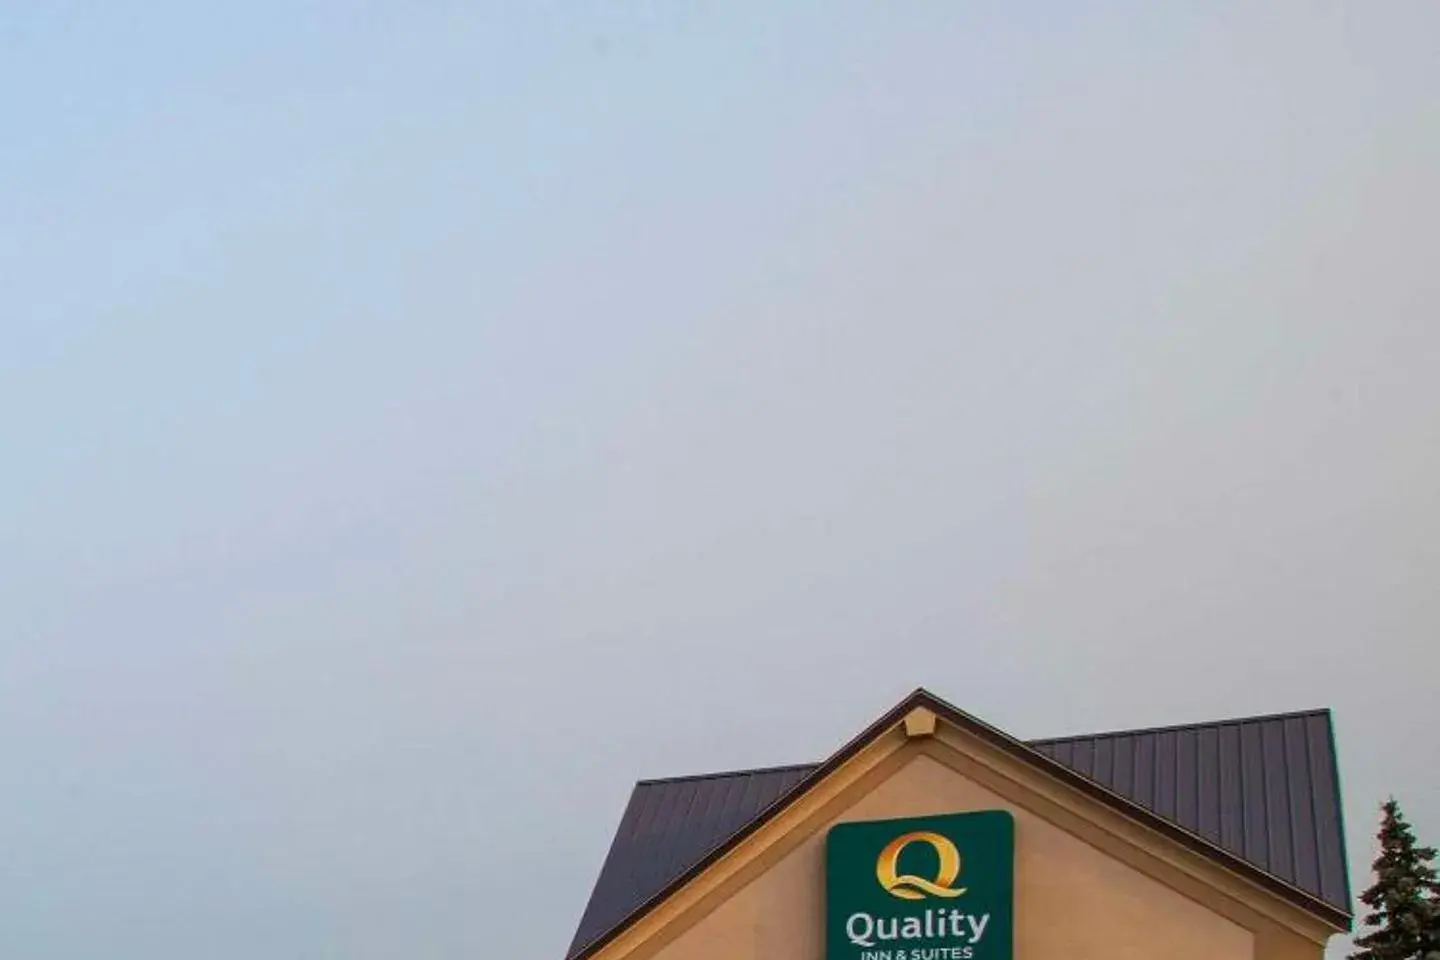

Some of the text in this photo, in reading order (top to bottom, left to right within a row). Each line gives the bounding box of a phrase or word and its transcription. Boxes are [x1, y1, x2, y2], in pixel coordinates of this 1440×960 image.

[876, 831, 968, 900] Q
[846, 908, 991, 947] Quality
[896, 949, 907, 960] &
[911, 946, 973, 960] SUITES
